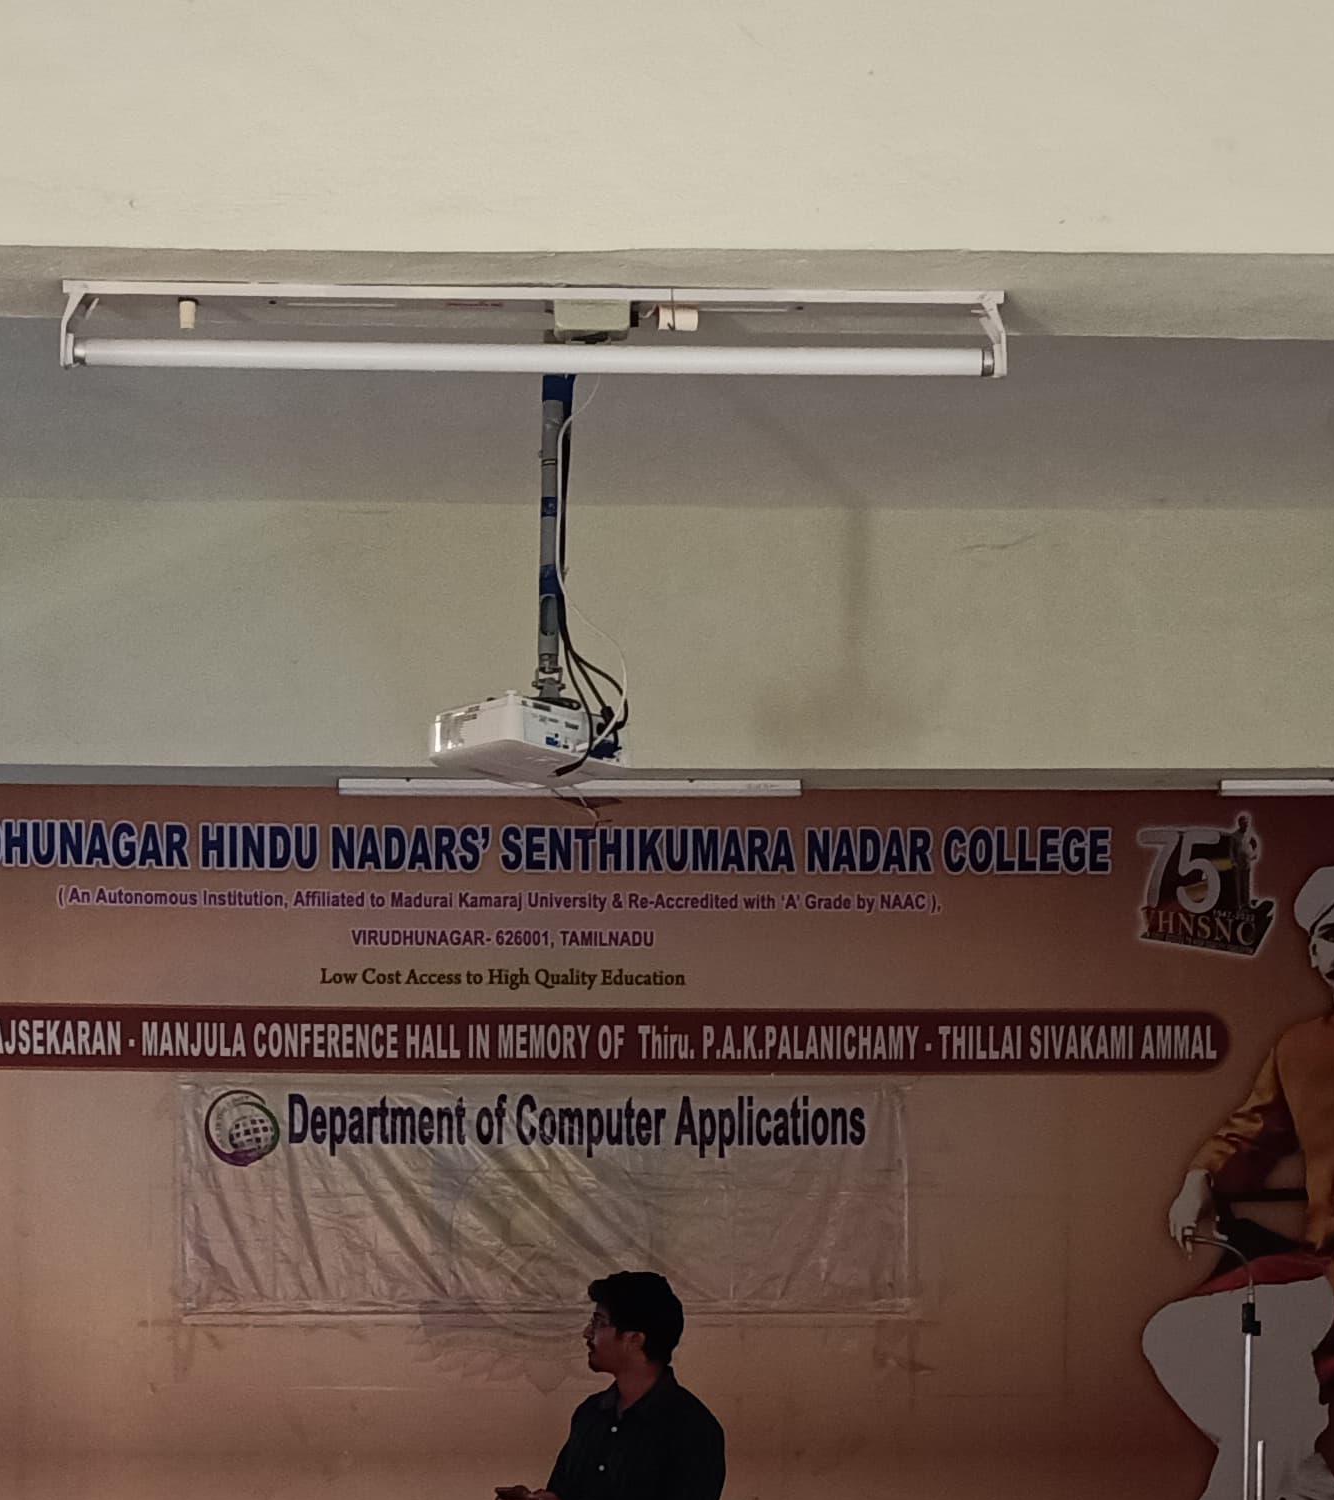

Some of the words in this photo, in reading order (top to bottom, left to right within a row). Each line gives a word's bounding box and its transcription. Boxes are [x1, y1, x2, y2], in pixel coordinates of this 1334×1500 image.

[202, 826, 318, 870] HINDU
[332, 826, 491, 871] NADARS'
[501, 827, 793, 873] SENTHIKUMARA
[806, 828, 933, 872] NADAR
[943, 828, 1112, 873] COLLEGE
[1138, 829, 1220, 914] 75
[95, 888, 197, 906] Autonomous
[202, 890, 290, 909] Institution,
[294, 890, 365, 907] Affiliated
[370, 892, 385, 908] to
[389, 891, 453, 908] Madurai
[458, 892, 522, 913] Kamaraj
[529, 892, 607, 913] University
[612, 893, 624, 909] &
[629, 892, 740, 910] Re-Accredited
[745, 893, 776, 910] with
[805, 894, 851, 910] Grade
[857, 894, 875, 915] by
[495, 929, 555, 950] 626001,
[560, 930, 654, 947] TAMILNADU
[1141, 908, 1255, 946] VHNSNC
[320, 968, 357, 986] Low
[362, 968, 402, 986] Cost
[406, 968, 462, 986] Access
[466, 970, 482, 986] to
[486, 968, 530, 991] High
[534, 968, 598, 991] Quality
[601, 969, 685, 987] Education
[141, 1021, 247, 1058] MANJULA
[253, 1022, 399, 1059] CONFERENCE
[406, 1023, 462, 1059] HALL
[467, 1024, 490, 1059] IN
[497, 1024, 592, 1060] MEMORY
[597, 1024, 624, 1060] OF
[637, 1025, 696, 1060] Thiru.
[702, 1025, 919, 1060] P.A.K.PALANICHAMY
[938, 1025, 1023, 1060] THILLAI
[1029, 1024, 1134, 1060] SIVAKAMI
[1140, 1024, 1218, 1060] AMMAL
[288, 1093, 466, 1156] Department
[476, 1093, 507, 1145] of
[516, 1094, 666, 1158] Computer
[674, 1095, 865, 1158] Applications
